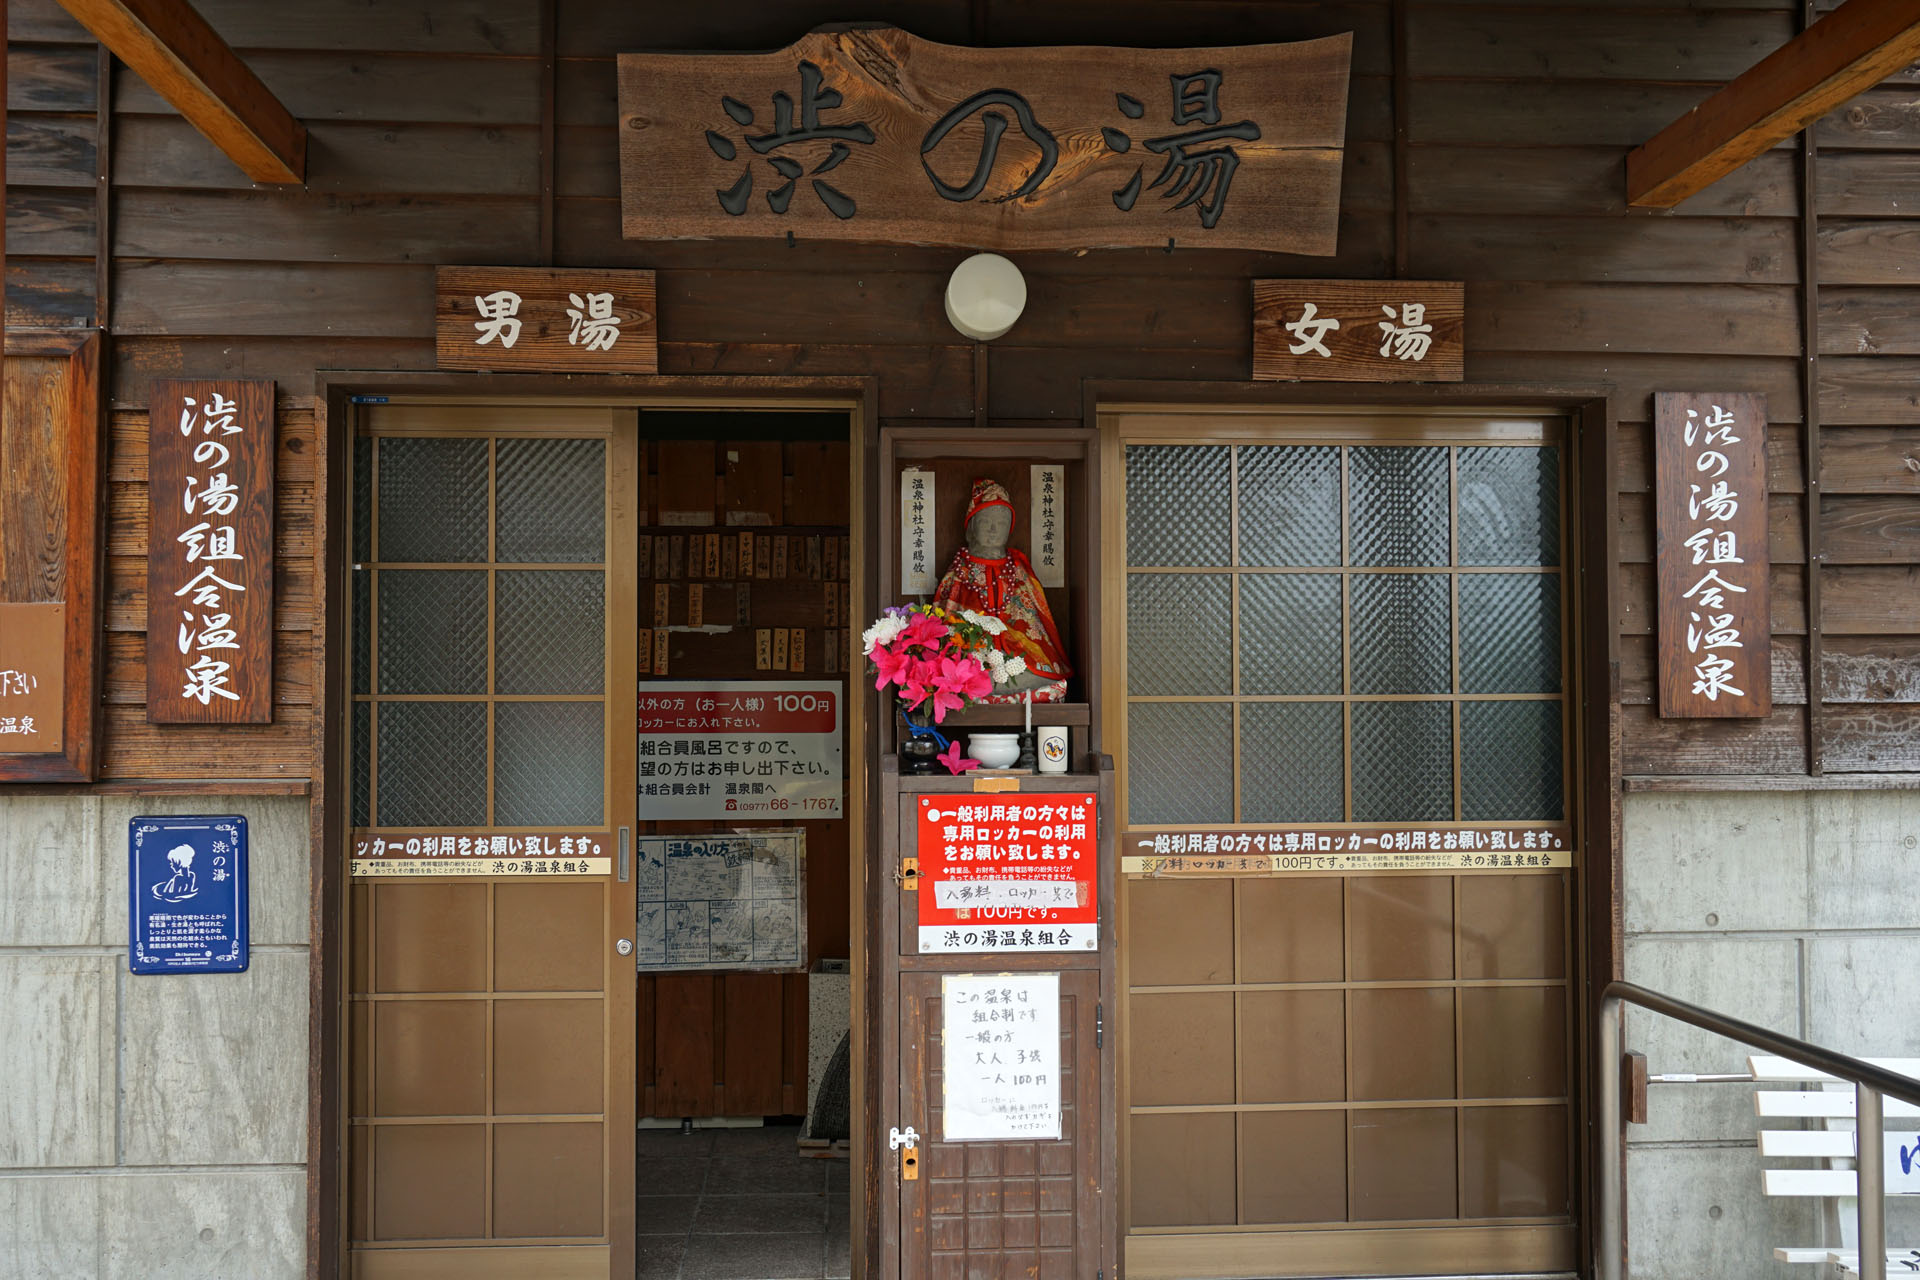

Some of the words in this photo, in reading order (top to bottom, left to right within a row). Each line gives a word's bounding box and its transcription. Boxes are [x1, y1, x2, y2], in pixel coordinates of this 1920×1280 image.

[704, 59, 1262, 229] 渋の湯
[474, 290, 622, 351] 男湯
[1285, 302, 1433, 361] 女湯
[174, 391, 247, 706] 渋の湯組合温泉
[1682, 404, 1748, 701] 渋の湯組合温泉
[773, 694, 830, 712] 100円
[0, 715, 39, 736] 温泉
[640, 740, 798, 756] 組合員風呂ですので、
[640, 760, 830, 777] 望の方はお申し出下さい。
[724, 782, 777, 795] 温泉閣へ
[941, 805, 1086, 822] 一般利用者の方々は
[942, 824, 1086, 842] 専用ロッカーの利用
[1138, 830, 1562, 853] 一般利用者の方々は専用ロッカーの利用をお願い致します。
[668, 843, 730, 858] 温泉の入り方
[944, 844, 1081, 861] をお願い致します。
[212, 840, 226, 881] 渋の湯
[492, 860, 590, 874] 渋の湯温泉組合
[1275, 856, 1345, 870] 100円です。
[1460, 853, 1553, 867] 渋の湯温泉組合
[944, 928, 1073, 947] 渋の湯温泉組合
[956, 988, 1028, 1004] この温泉は
[971, 1008, 1037, 1023] 組合制です
[965, 1030, 1015, 1043] 一般の方
